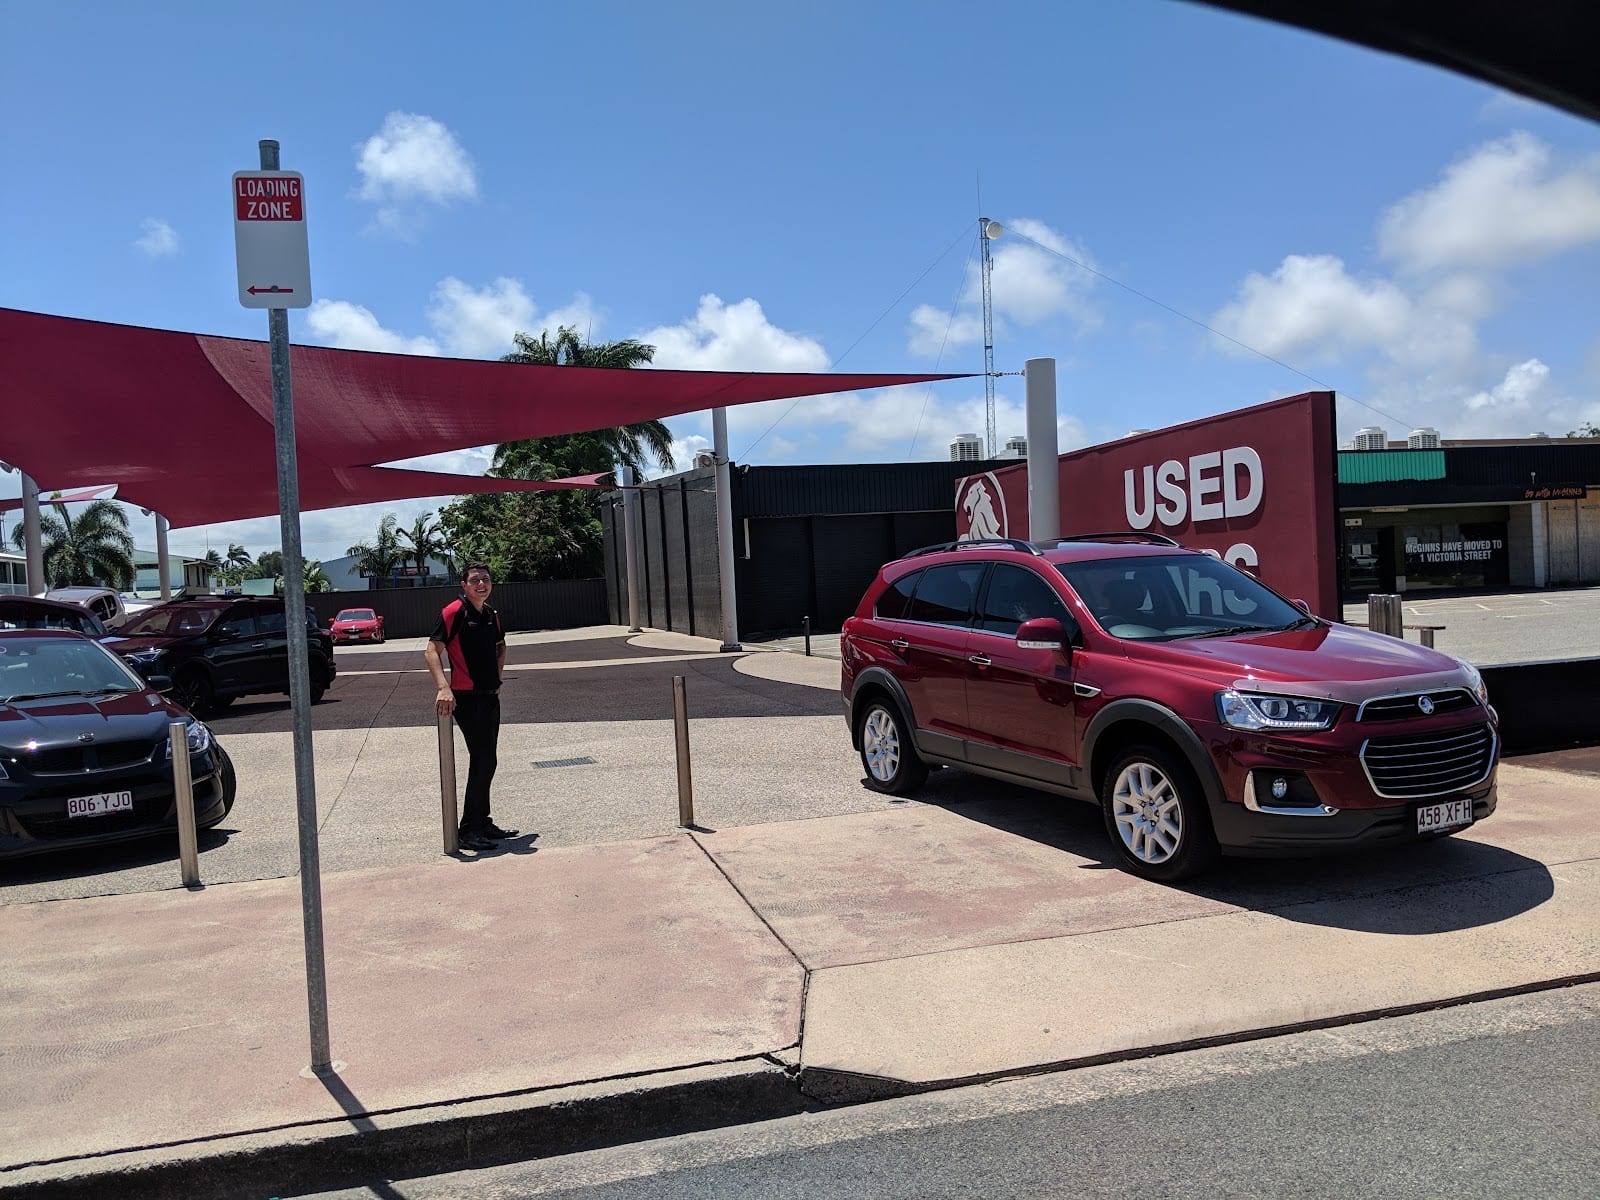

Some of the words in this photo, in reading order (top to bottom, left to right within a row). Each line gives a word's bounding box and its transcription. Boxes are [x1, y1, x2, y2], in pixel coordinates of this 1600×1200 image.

[238, 180, 298, 197] LOADING
[247, 201, 293, 219] ZONE
[1124, 446, 1264, 530] USED
[1442, 541, 1462, 551] HAVE
[1464, 540, 1491, 551] MOVED
[1492, 539, 1502, 549] TO
[1426, 552, 1463, 562] VICTORIA
[1464, 550, 1492, 560] STREET
